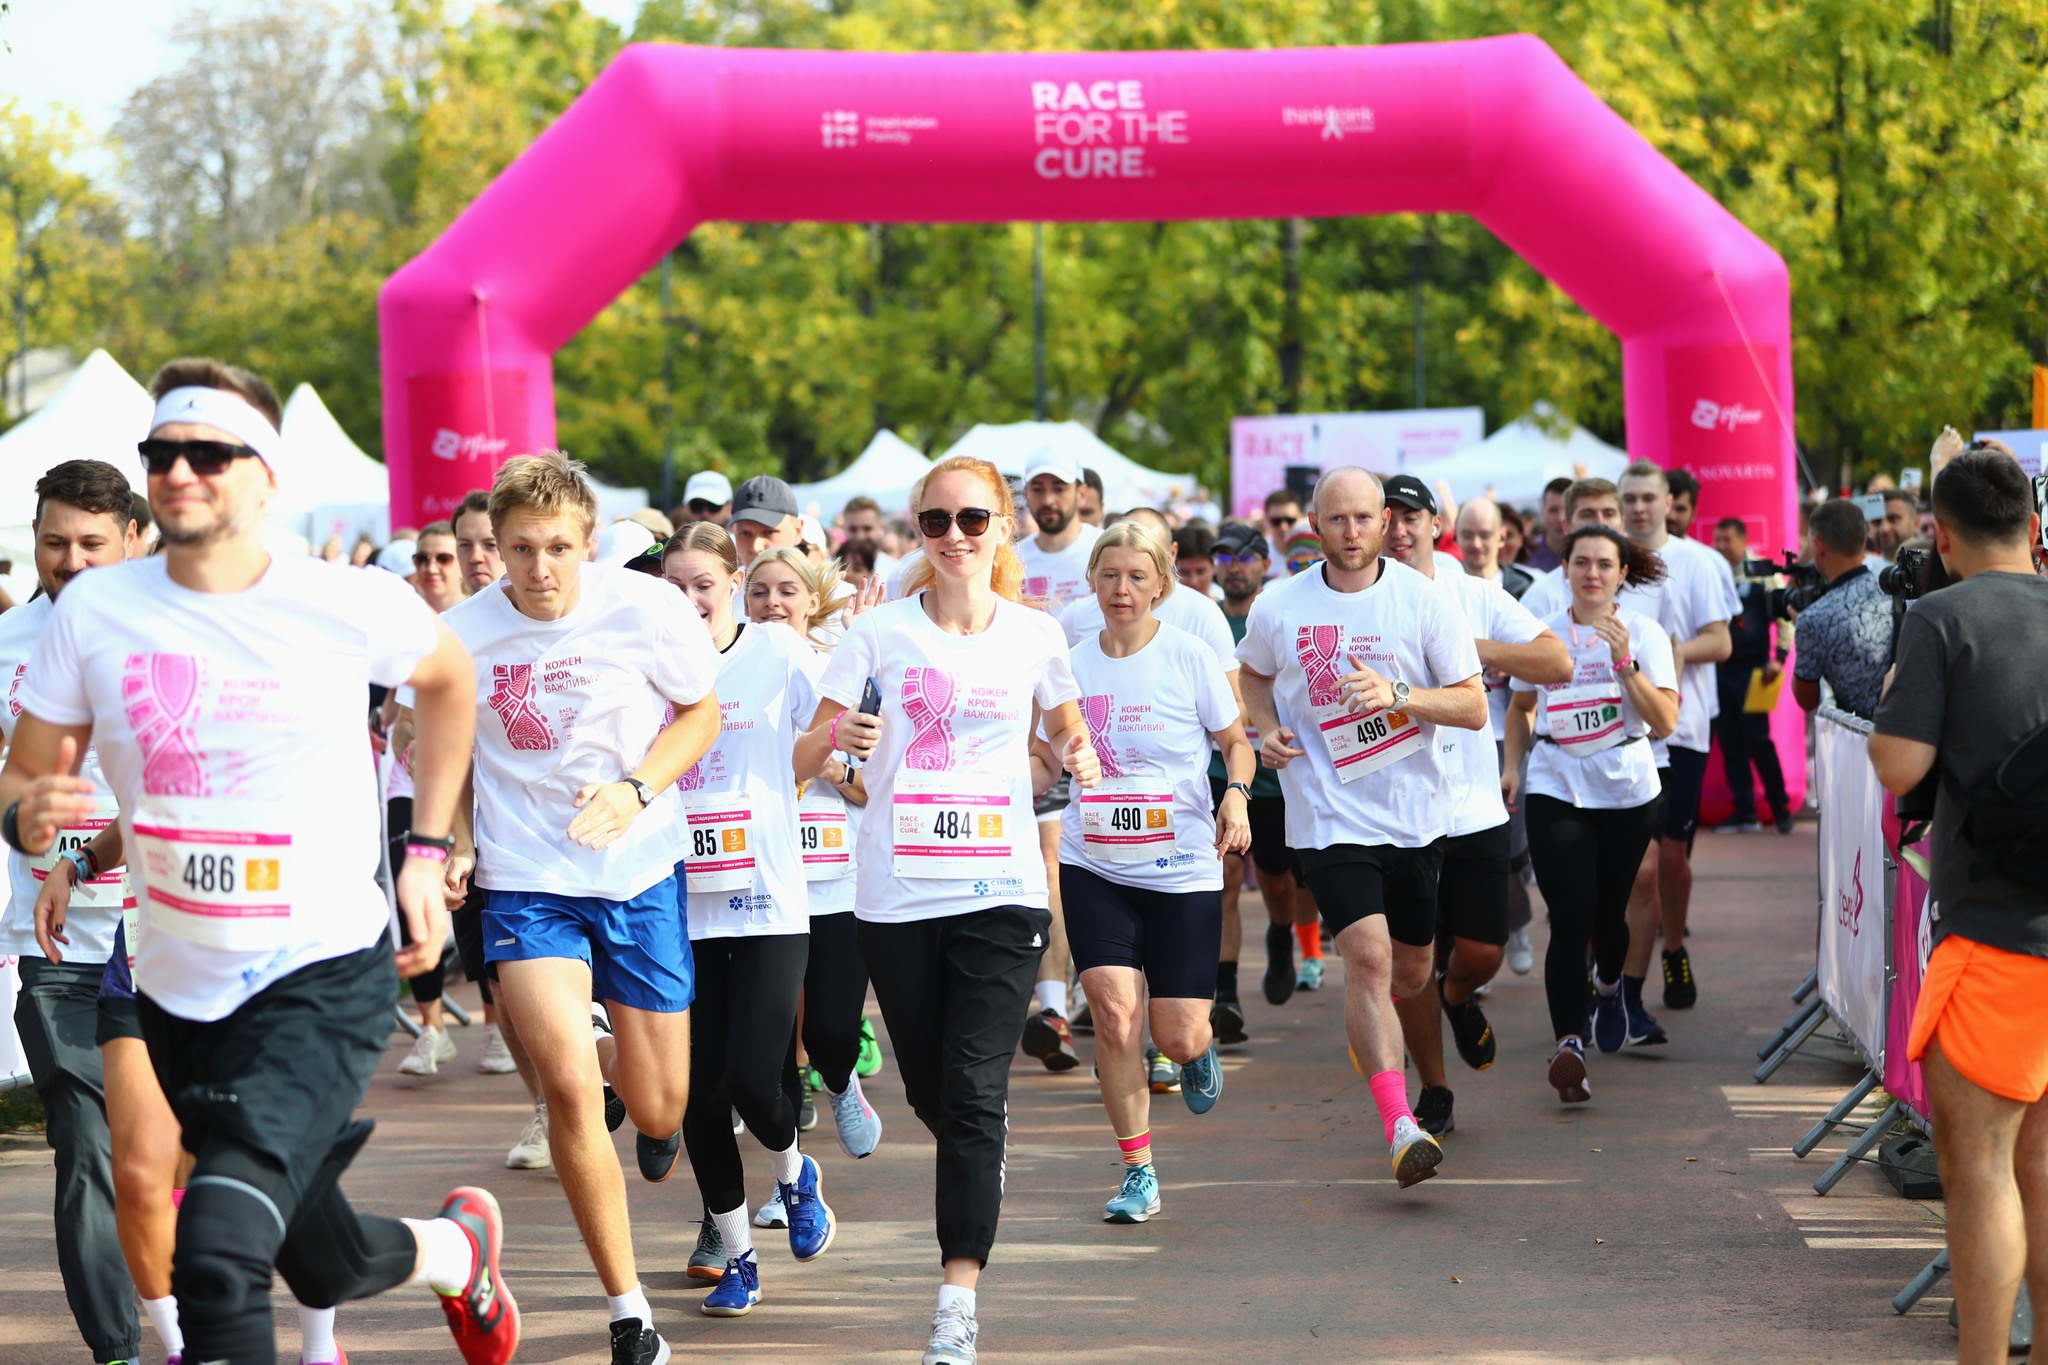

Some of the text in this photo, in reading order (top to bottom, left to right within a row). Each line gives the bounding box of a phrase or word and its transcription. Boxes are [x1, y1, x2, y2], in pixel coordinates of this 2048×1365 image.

[1031, 80, 1145, 111] RACE
[1035, 110, 1189, 145] FOR THE
[1701, 463, 1776, 480] NOVARTIS
[1400, 487, 1418, 497] NASA
[1347, 652, 1394, 662] ВЖЛИВИЙ
[545, 656, 582, 671] КОЖЕН
[543, 670, 571, 682] КРОК
[971, 687, 1008, 697] КОЖЕН
[720, 701, 740, 711] ЖЕН
[968, 698, 996, 708] КРОК
[1121, 705, 1151, 713] КОЖЕН
[963, 709, 1019, 720] ВАЖЛИВИЙ
[1573, 710, 1600, 731] 173
[721, 719, 754, 731] ЛИВИЙ
[1117, 722, 1165, 732] ВАЖЛИВИЙ
[1357, 712, 1400, 744] 496 5
[1330, 735, 1344, 743] RACE
[1442, 742, 1455, 753] er
[1111, 807, 1160, 830] 490 5
[933, 811, 994, 839] 484 5
[693, 829, 738, 856] 85 5
[801, 826, 836, 849] 49 5
[183, 854, 234, 893] 486
[745, 903, 772, 912] synevo
